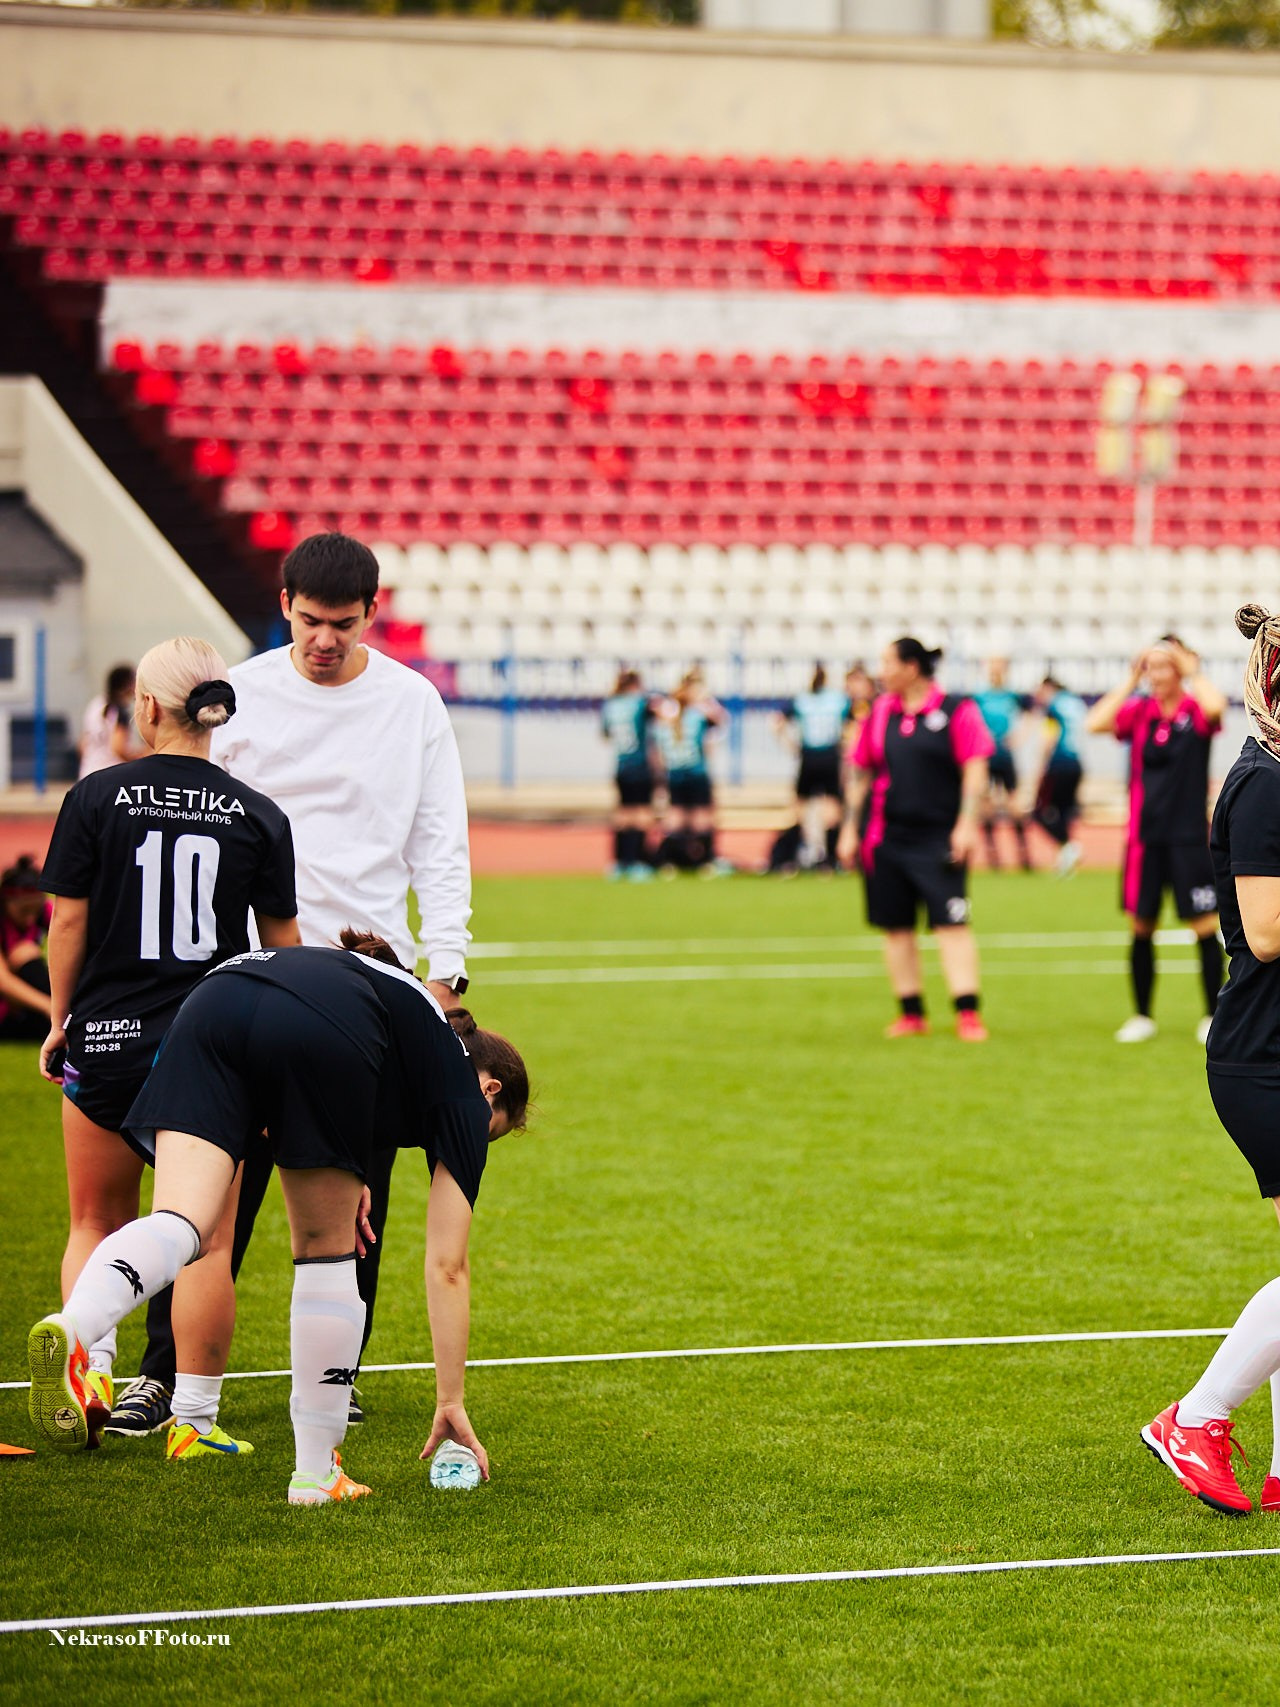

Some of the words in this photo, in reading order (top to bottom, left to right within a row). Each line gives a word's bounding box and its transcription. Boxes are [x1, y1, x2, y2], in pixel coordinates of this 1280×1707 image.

[128, 806, 202, 821] ФУТБОЛЬНЫЙ
[204, 813, 232, 825] КЛУБ
[136, 830, 221, 961] 10
[86, 1019, 141, 1032] ФУТБОЛ
[85, 1043, 120, 1052] 25-20-28
